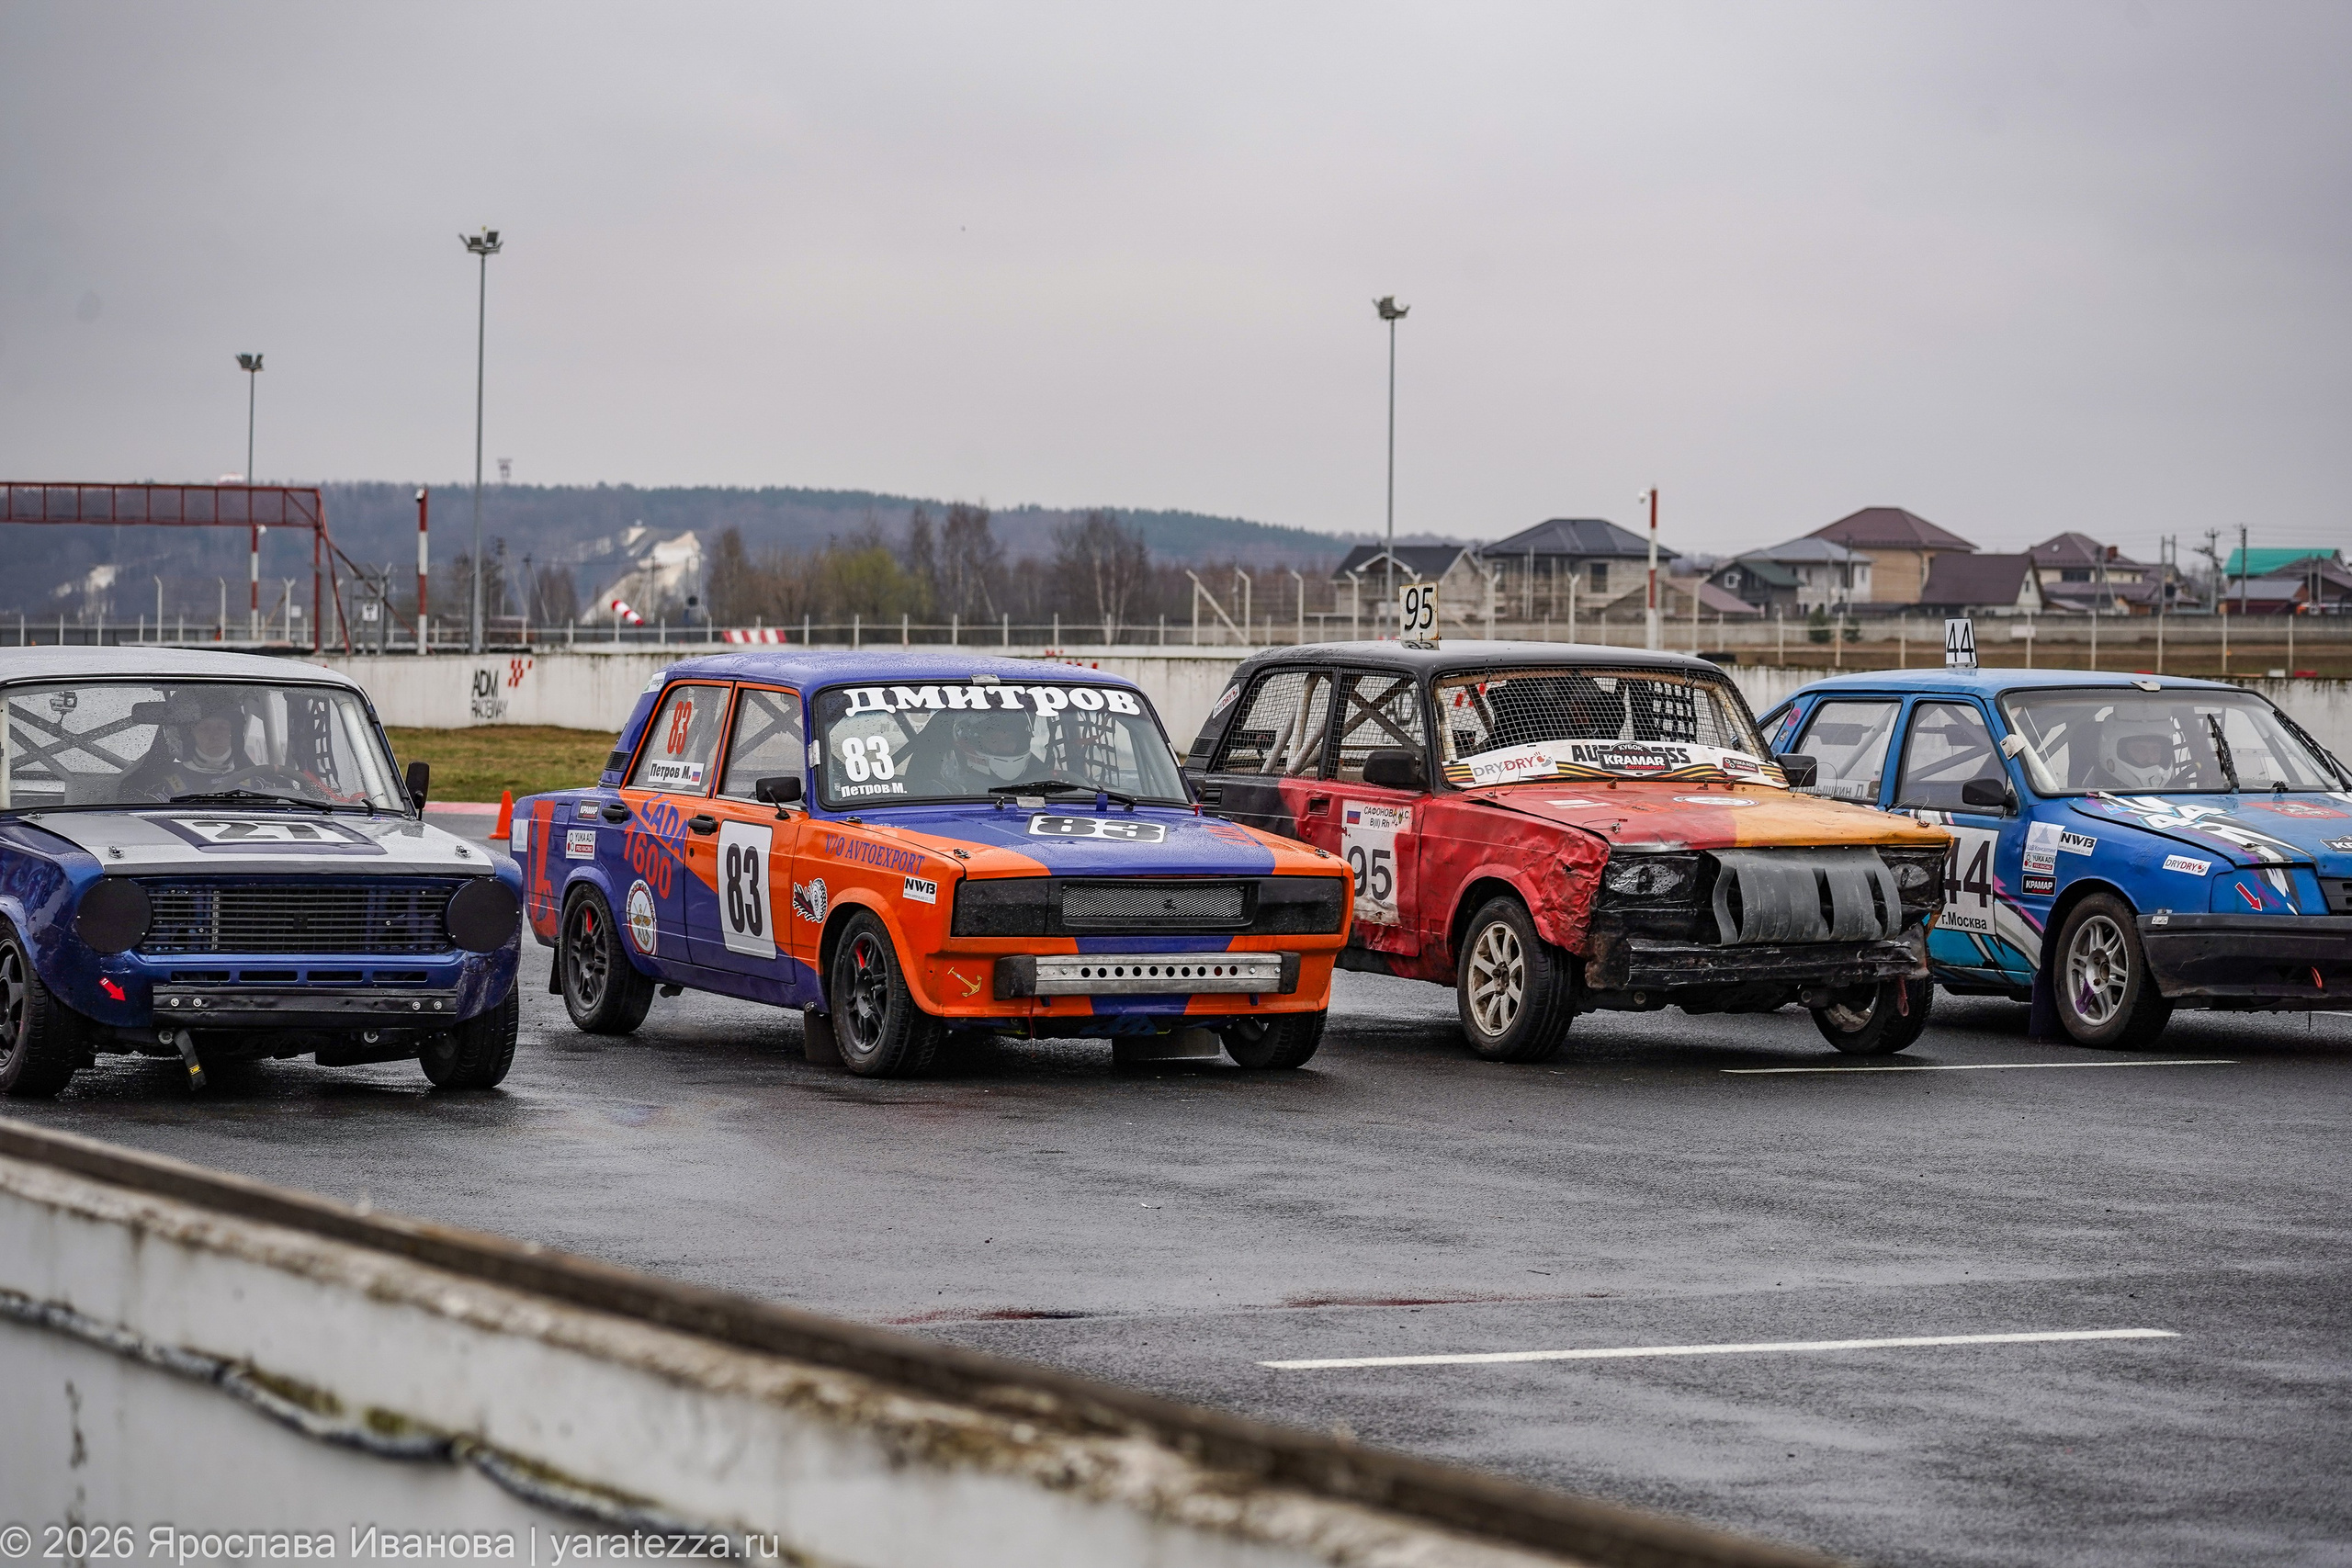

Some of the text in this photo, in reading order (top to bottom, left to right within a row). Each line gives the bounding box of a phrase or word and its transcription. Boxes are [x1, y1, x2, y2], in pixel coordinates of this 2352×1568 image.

[1405, 588, 1433, 631] 95
[1947, 623, 1974, 662] 44
[471, 670, 499, 698] ADM
[667, 700, 693, 755] 83
[650, 763, 691, 780] Петров М.
[842, 736, 895, 783] 83
[1603, 753, 1666, 766] KRAMAR
[892, 783, 908, 794] М.
[640, 793, 690, 860] LADA
[1037, 817, 1161, 840] 83
[2143, 804, 2228, 829] 44
[192, 821, 322, 840] 21
[2060, 832, 2095, 848] NWB
[624, 820, 672, 899] 1600
[845, 839, 925, 874] AVTOEXPORT
[2165, 859, 2198, 872] DRYDRY
[1347, 845, 1392, 900] 95
[1945, 837, 1992, 908] 44
[2025, 880, 2053, 890] КРАМАР
[726, 842, 763, 937] 83
[905, 877, 936, 895] NWB
[1941, 911, 1988, 930] г.Москва
